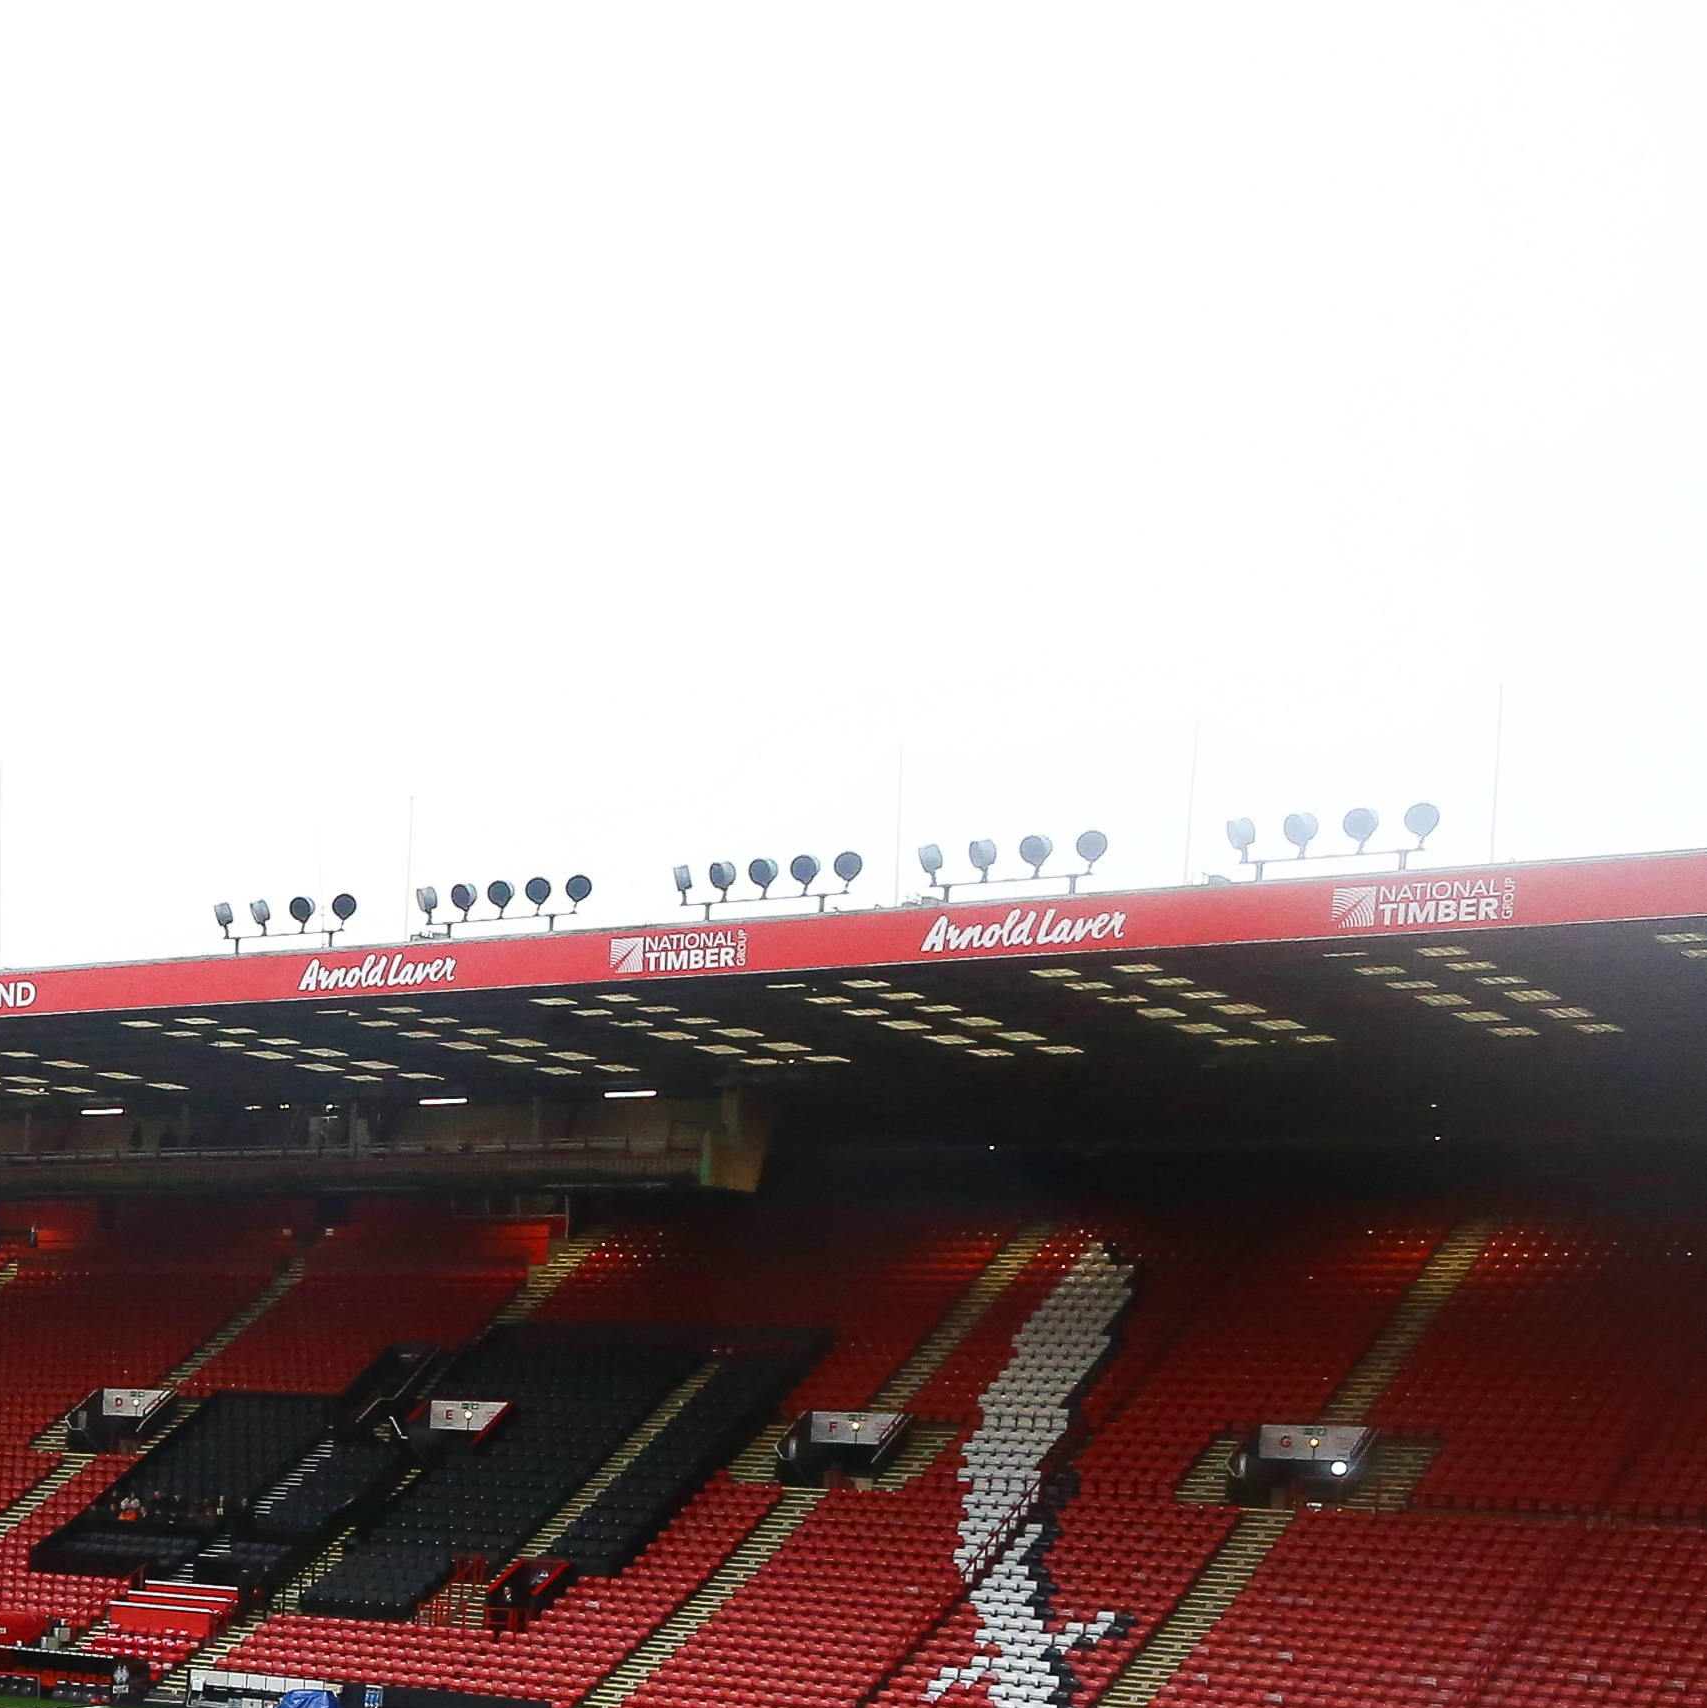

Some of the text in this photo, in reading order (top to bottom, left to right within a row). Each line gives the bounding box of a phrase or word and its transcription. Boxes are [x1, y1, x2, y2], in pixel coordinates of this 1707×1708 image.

[1378, 878, 1502, 903] NATIONAL
[1501, 876, 1517, 920] GROUP
[1379, 896, 1500, 927] TIMBER
[645, 930, 738, 952] NATIONAL
[921, 907, 1127, 954] Arnold Laver
[645, 947, 736, 972] TIMBER
[737, 929, 749, 967] GROUP
[298, 952, 458, 992] Arnold Laver
